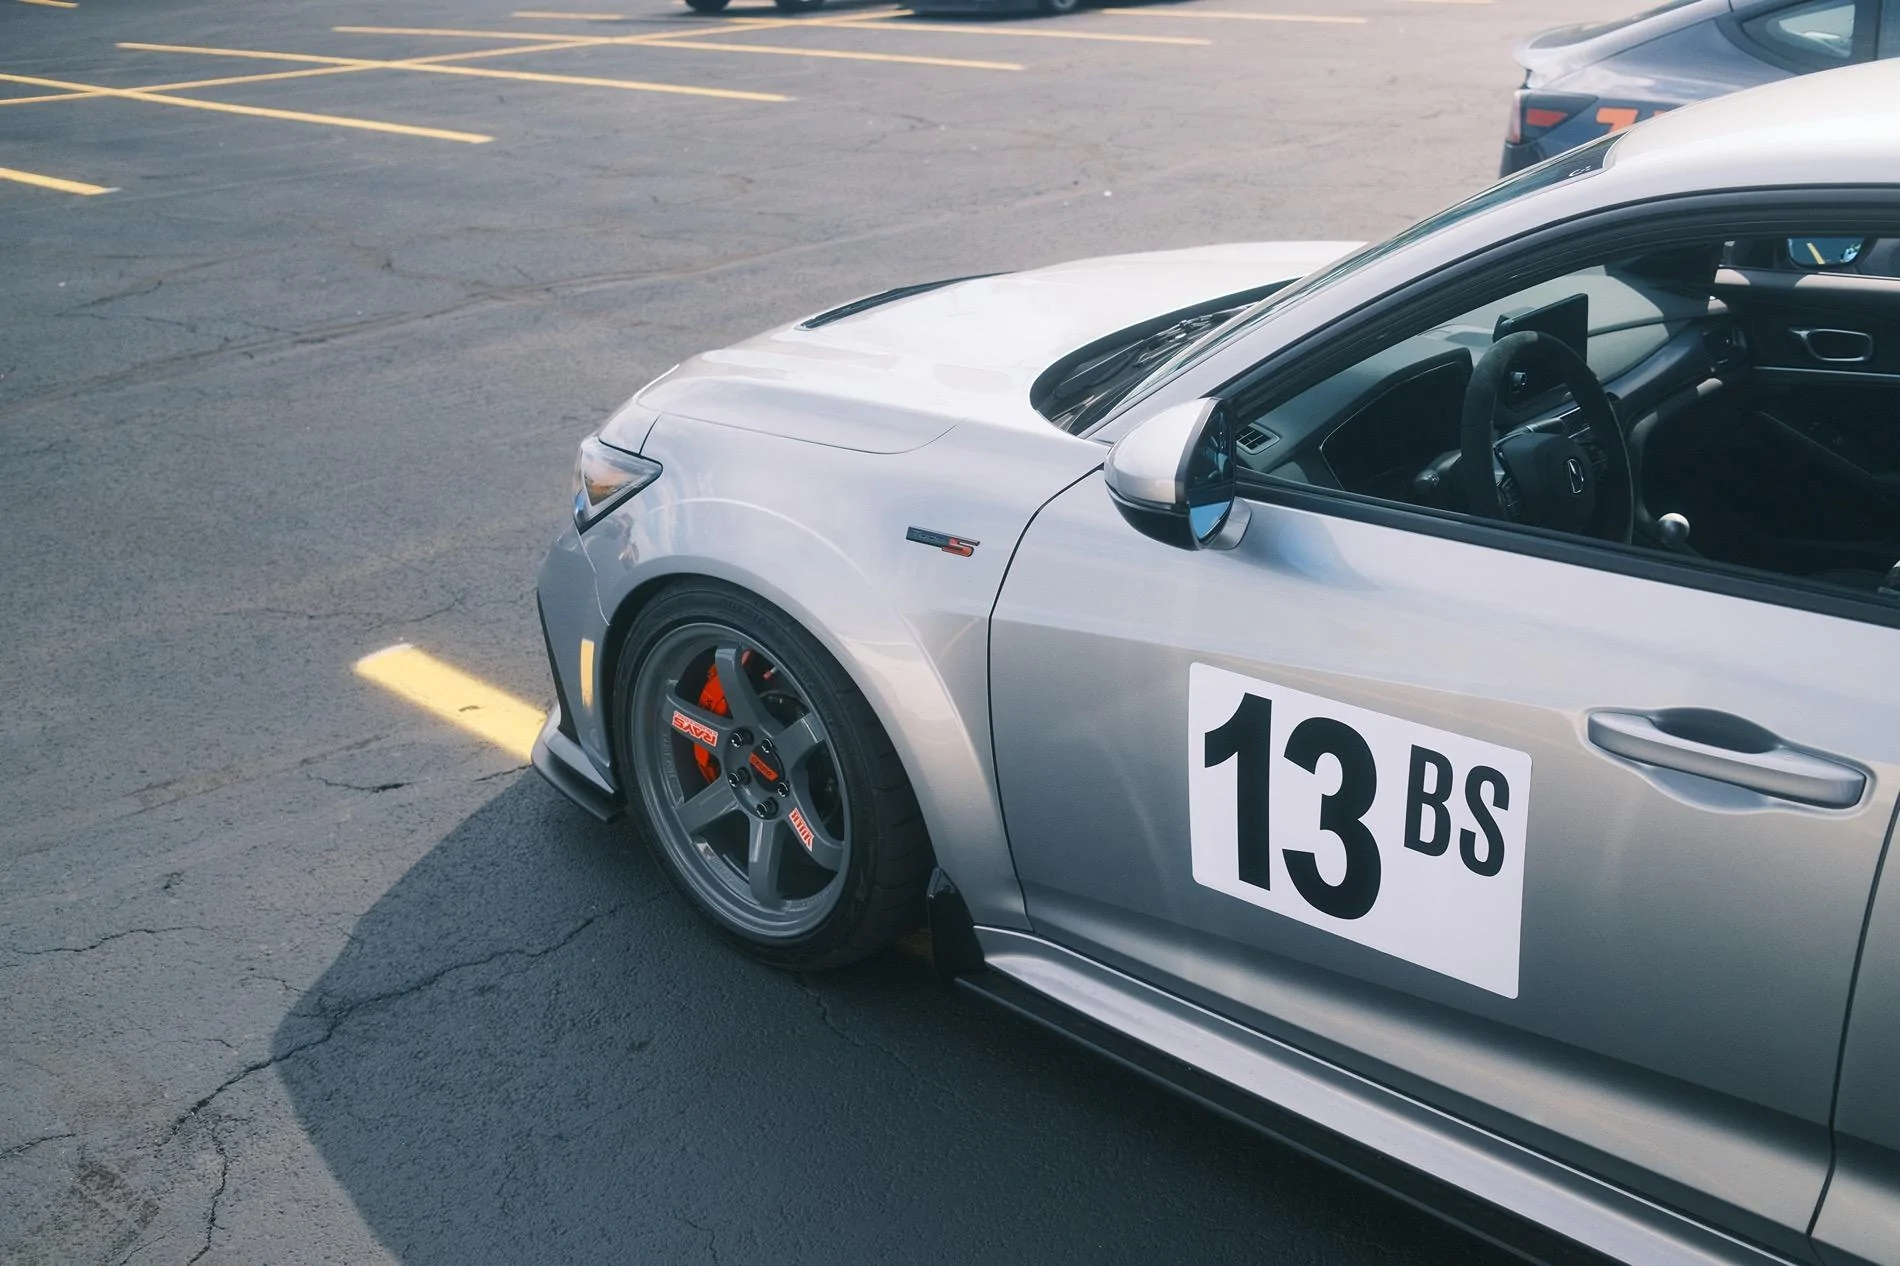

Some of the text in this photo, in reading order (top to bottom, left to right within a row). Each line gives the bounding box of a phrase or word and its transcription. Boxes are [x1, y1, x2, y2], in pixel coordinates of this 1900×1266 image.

[672, 715, 717, 746] RAYS
[1204, 691, 1510, 920] 13 BS
